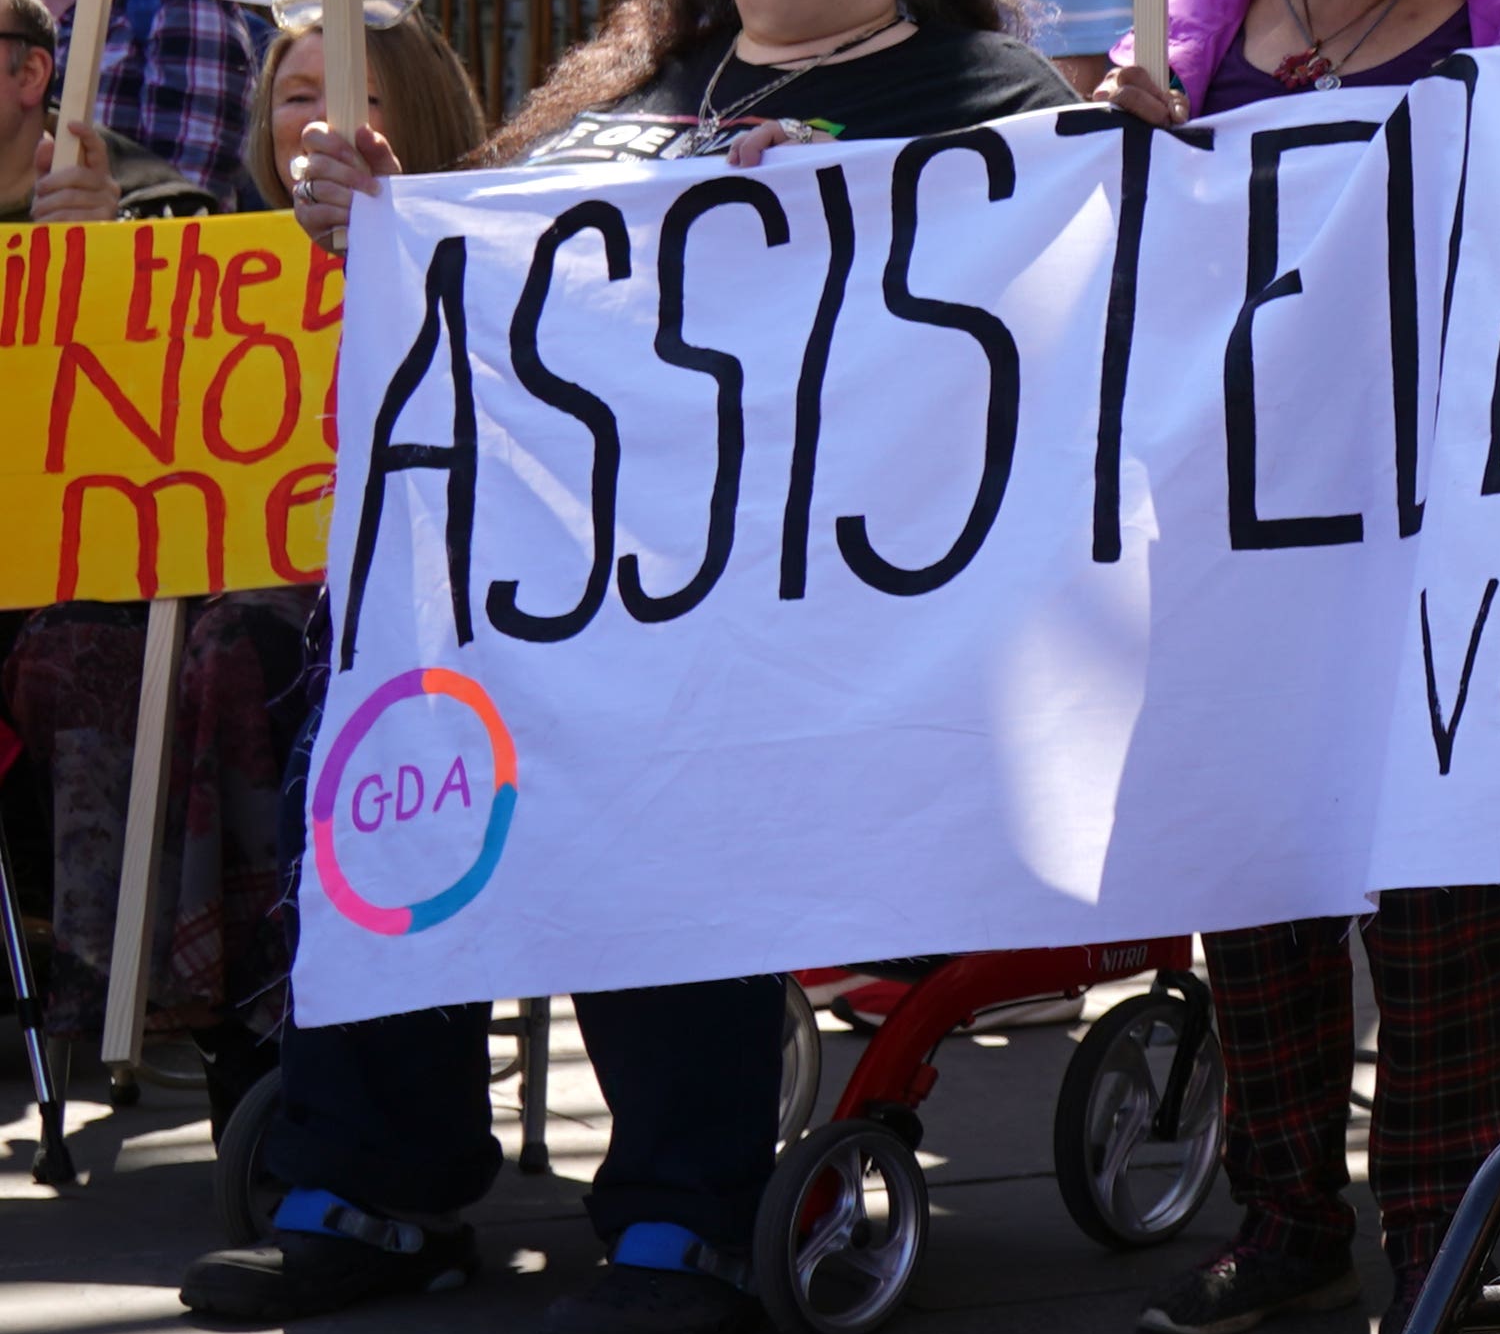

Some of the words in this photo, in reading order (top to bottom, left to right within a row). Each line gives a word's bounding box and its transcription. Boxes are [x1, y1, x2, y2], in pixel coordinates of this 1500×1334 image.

[0, 224, 86, 347] ill
[125, 221, 282, 342] the
[44, 331, 342, 473] NO
[56, 462, 338, 602] me
[352, 755, 473, 834] GDA
[1100, 944, 1149, 972] NITRO
